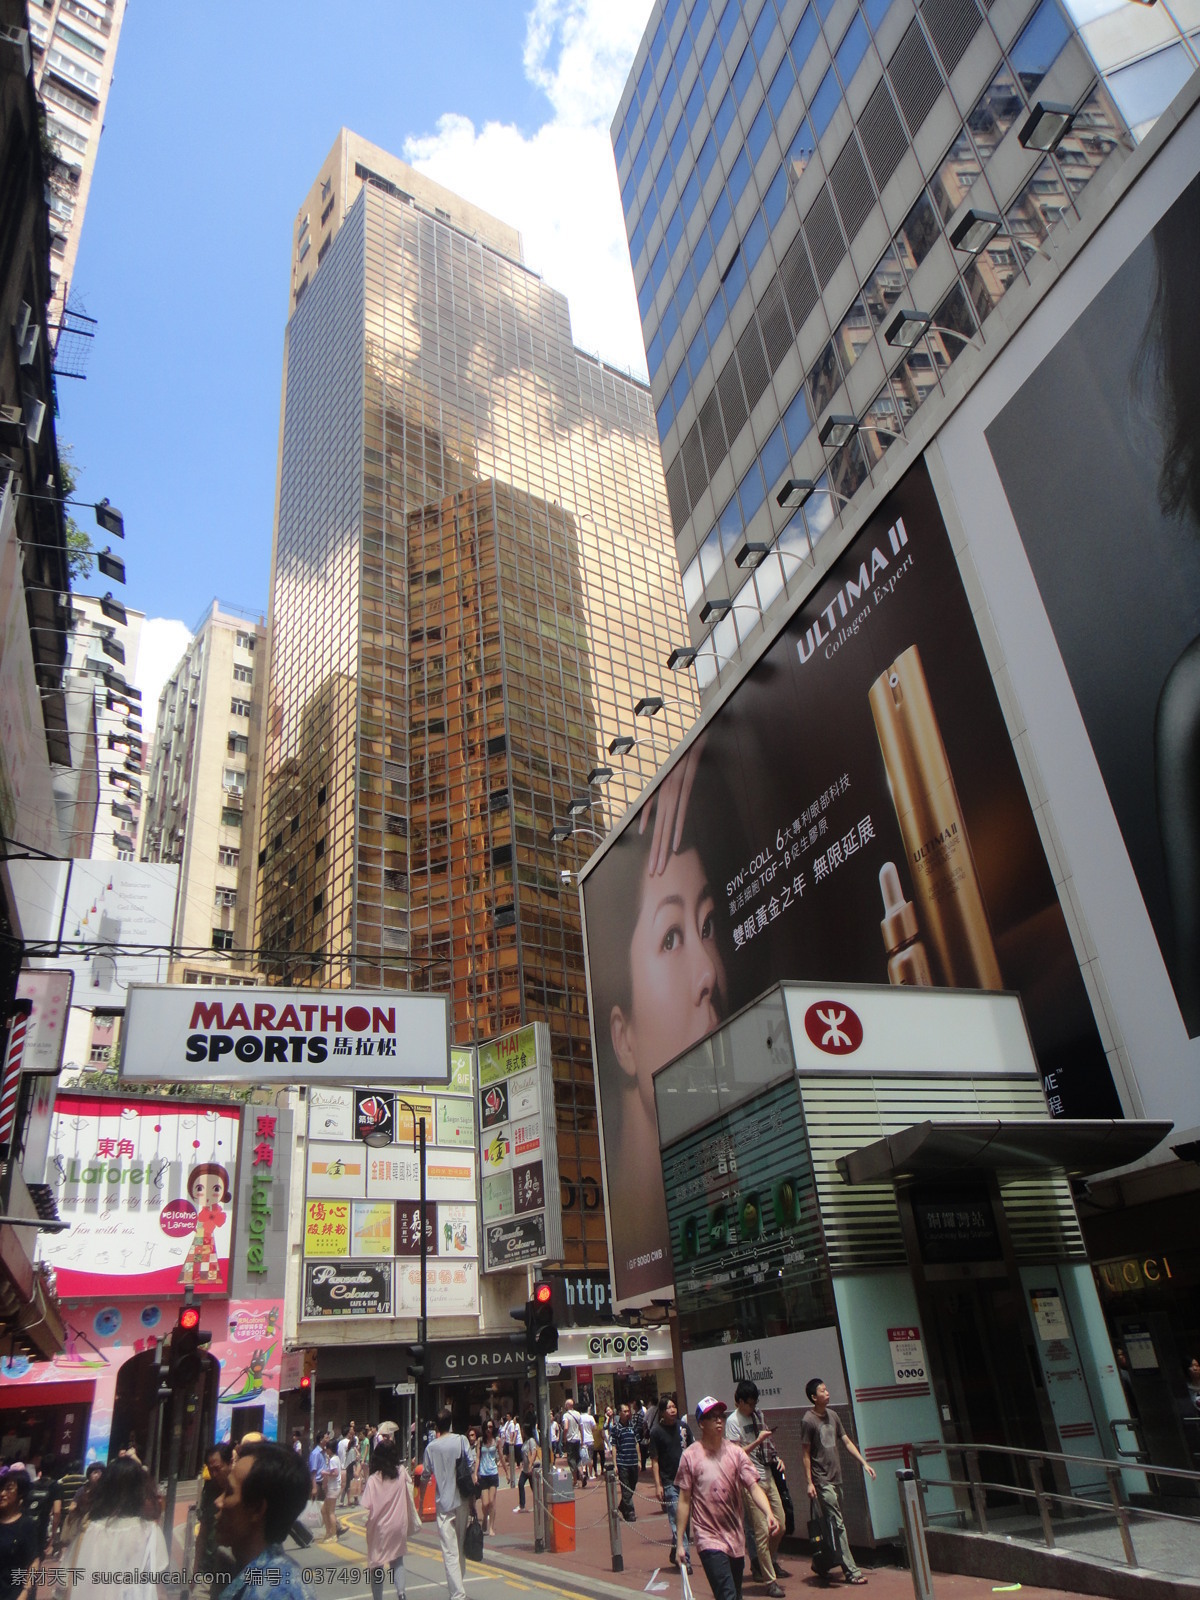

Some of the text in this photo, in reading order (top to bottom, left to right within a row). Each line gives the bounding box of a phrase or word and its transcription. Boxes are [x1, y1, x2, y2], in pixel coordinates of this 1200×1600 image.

[796, 517, 909, 664] ULTIMA II
[825, 554, 915, 660] Collagen Expert
[914, 828, 952, 862] ULTIMA
[732, 873, 807, 951] 雙眼黃金之年
[812, 815, 876, 884] 無限延展
[189, 1001, 395, 1032] MARATHON
[186, 1034, 397, 1063] SPORTS 馬拉松
[495, 1033, 519, 1060] THAI
[457, 1073, 470, 1084] 8/F
[1048, 1095, 1065, 1116] 程
[97, 1138, 135, 1159] 東角
[253, 1114, 277, 1167] 東角
[69, 1161, 151, 1184] Laforet
[102, 1193, 116, 1204] the
[122, 1194, 140, 1208] city
[70, 1223, 89, 1237] fun
[94, 1223, 117, 1235] with
[247, 1175, 274, 1276] Laforet
[307, 1223, 348, 1236] 酸辣粉
[927, 1211, 986, 1229] 銅鑼灣站
[637, 1253, 651, 1267] SOGO
[651, 1248, 663, 1262] CWB
[312, 1265, 373, 1285] Pancake
[330, 1284, 380, 1299] Colours
[377, 1302, 390, 1313] 4/F
[589, 1335, 649, 1354] crocs
